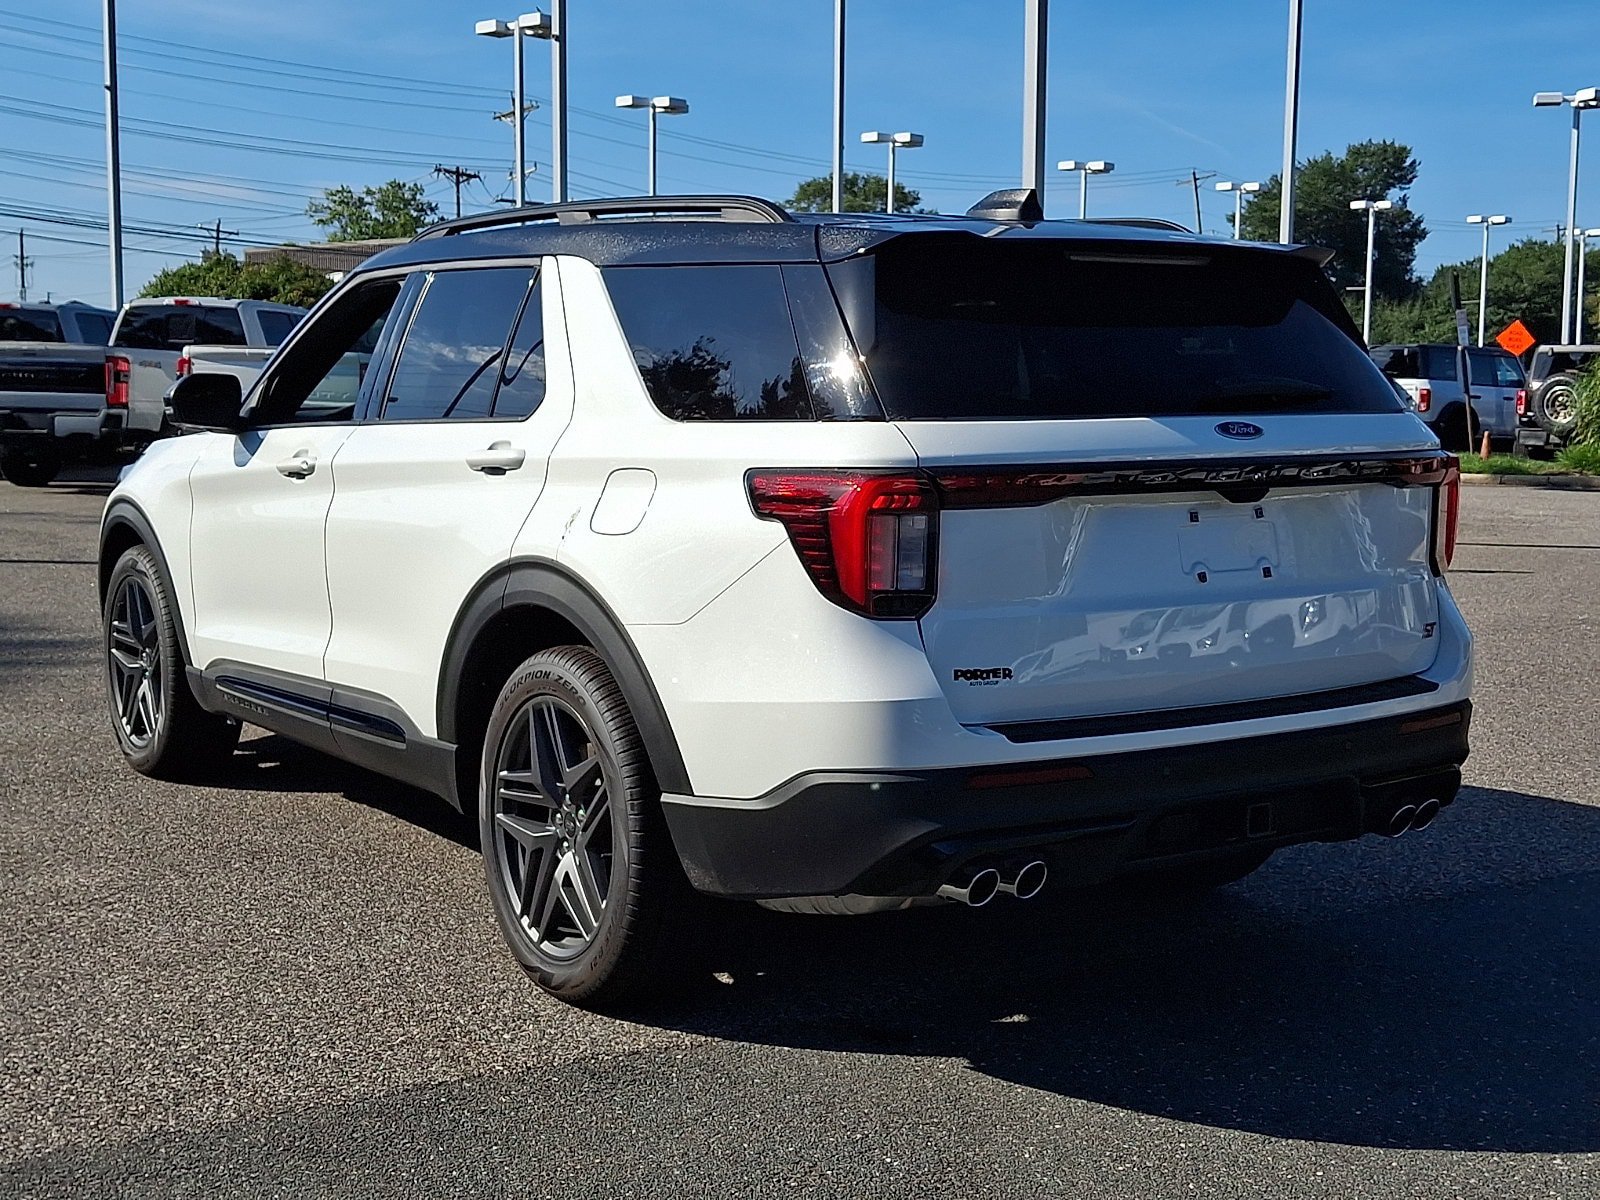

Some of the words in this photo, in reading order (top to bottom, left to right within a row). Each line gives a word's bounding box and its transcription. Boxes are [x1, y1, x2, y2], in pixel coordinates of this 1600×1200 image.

[953, 667, 1014, 681] PORTER
[499, 669, 552, 711] SCORPION
[554, 674, 587, 707] ZERO
